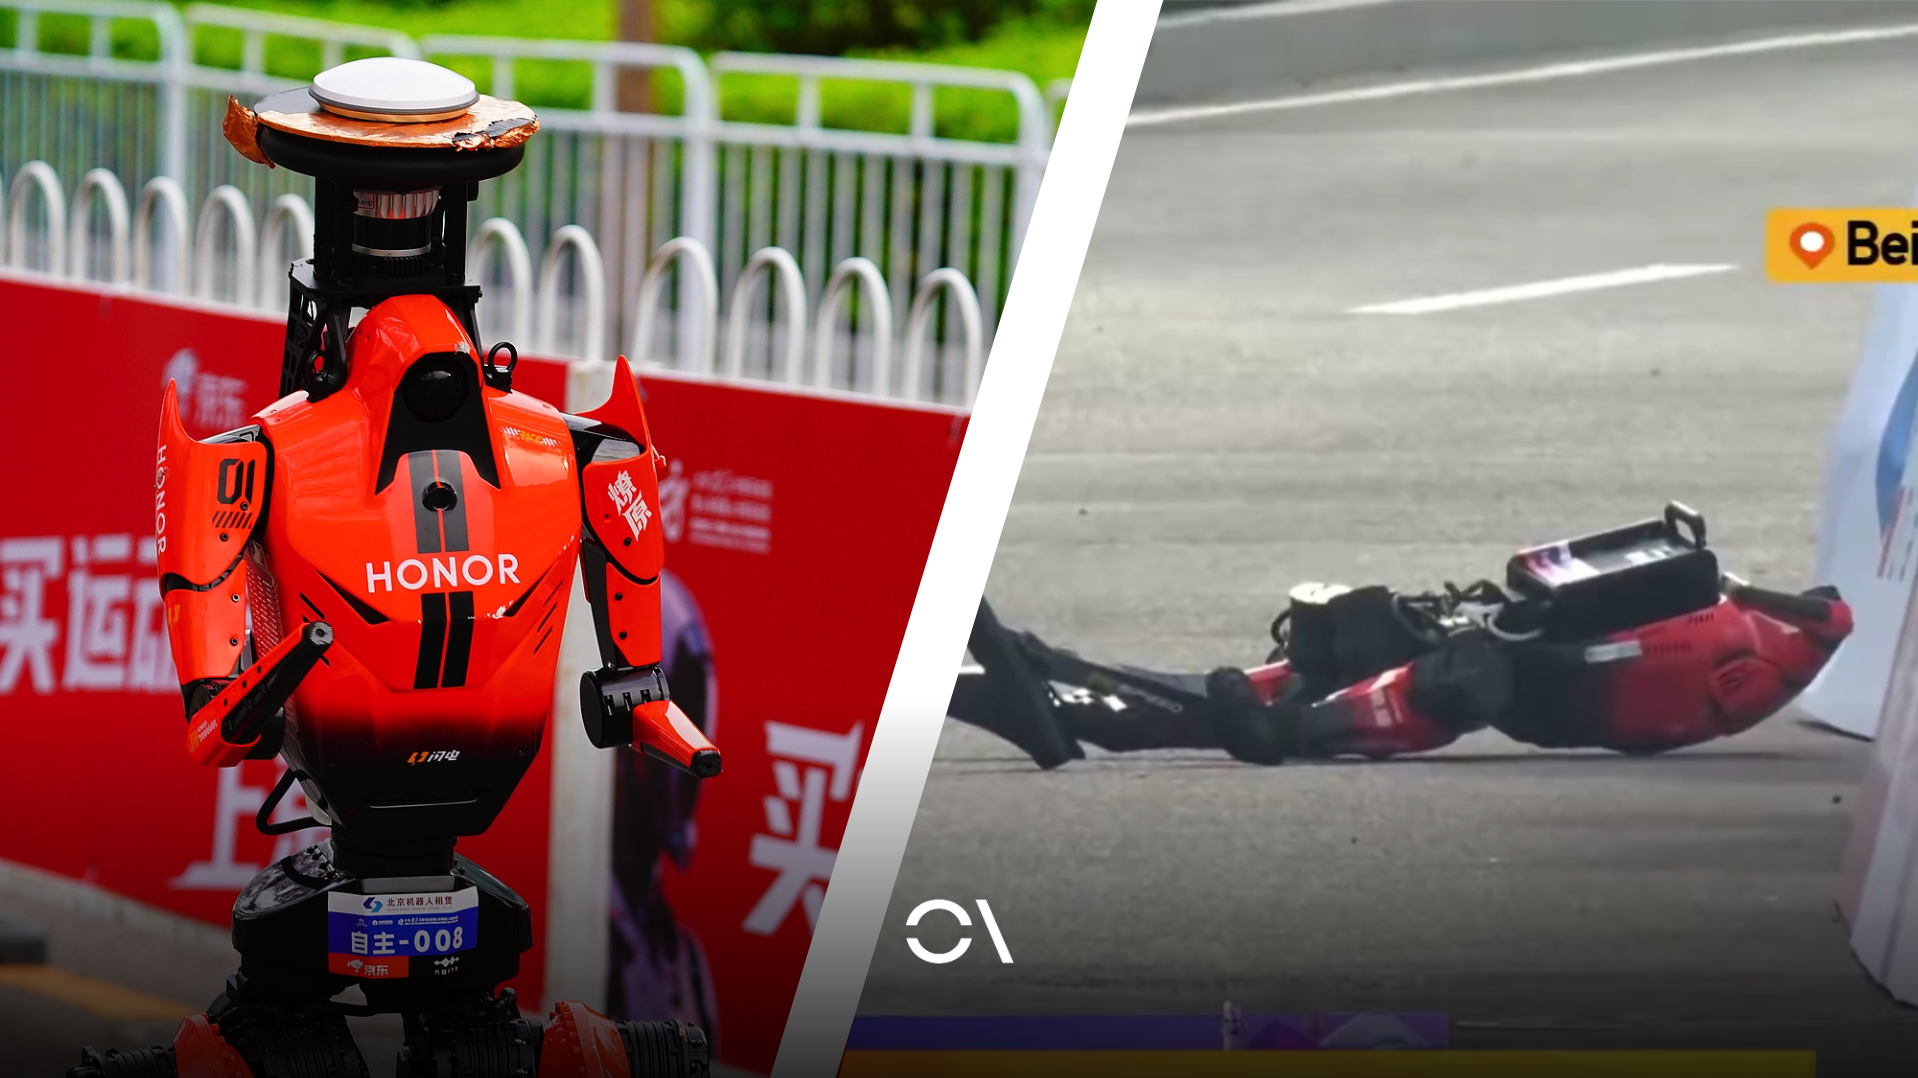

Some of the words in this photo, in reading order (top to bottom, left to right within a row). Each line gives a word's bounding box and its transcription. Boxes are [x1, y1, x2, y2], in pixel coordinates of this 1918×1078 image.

[155, 444, 167, 553] HONOR
[217, 458, 256, 505] 01
[608, 470, 652, 542] 燎原
[366, 553, 521, 593] HONOR
[427, 750, 460, 763] 闪电
[387, 896, 453, 907] 北京机器人租赁
[351, 926, 463, 955] 自主-008
[364, 965, 389, 976] 京东
